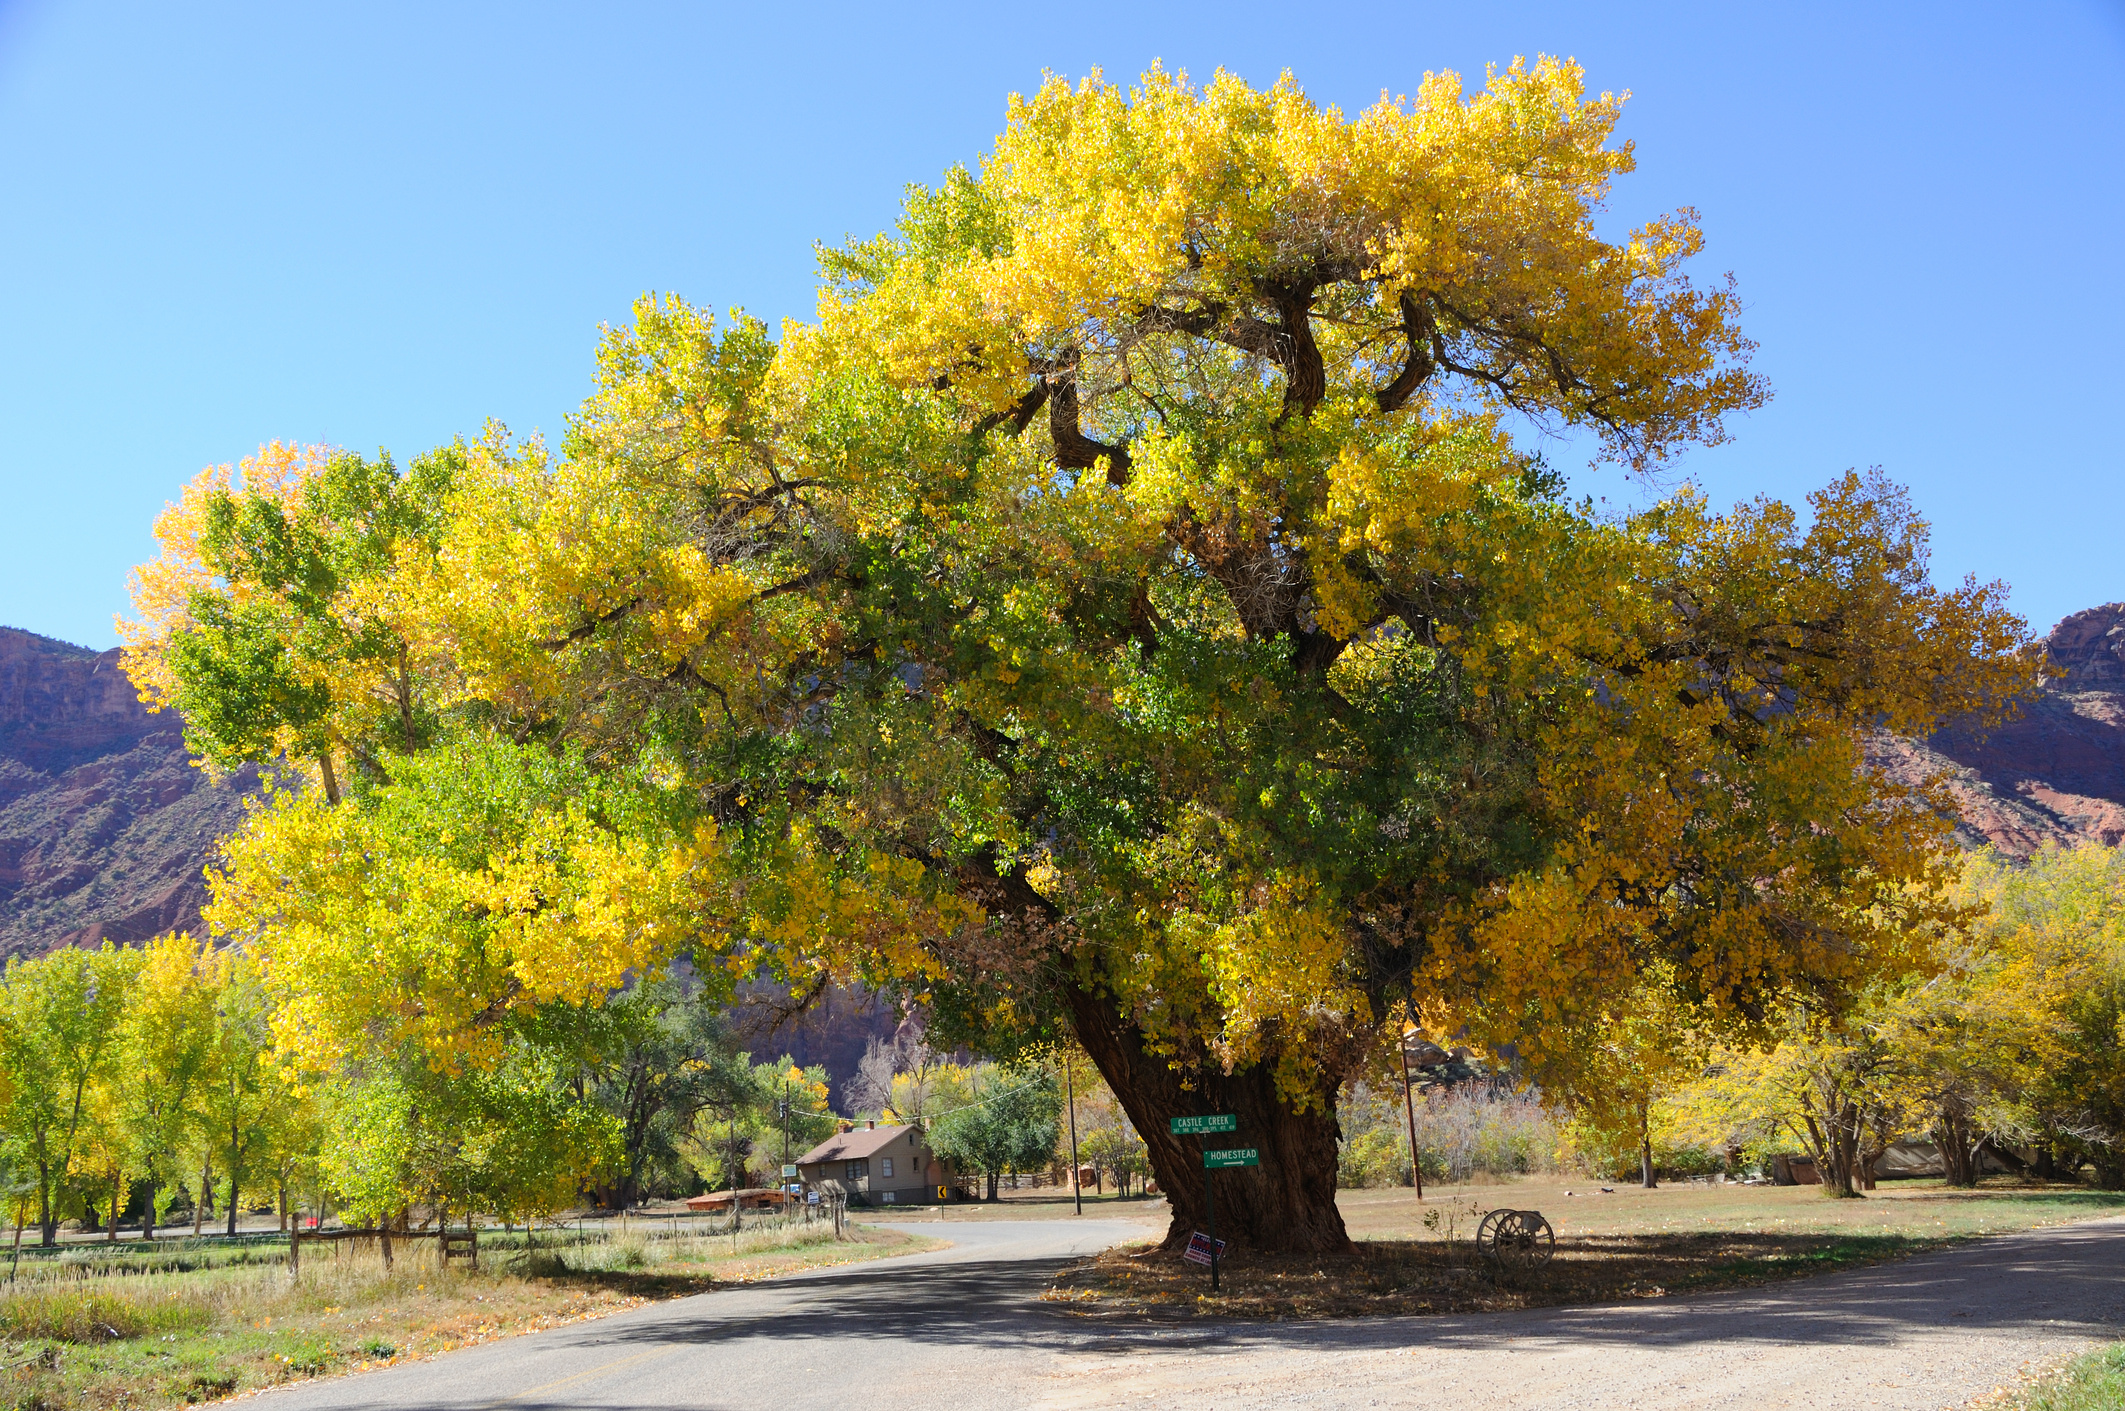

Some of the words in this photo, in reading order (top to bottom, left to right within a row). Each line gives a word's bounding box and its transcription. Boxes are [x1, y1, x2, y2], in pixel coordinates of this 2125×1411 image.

[1178, 1118, 1202, 1127] CASTLE
[1208, 1116, 1229, 1125] CREEK
[1211, 1150, 1256, 1160] HOMESTEAD
